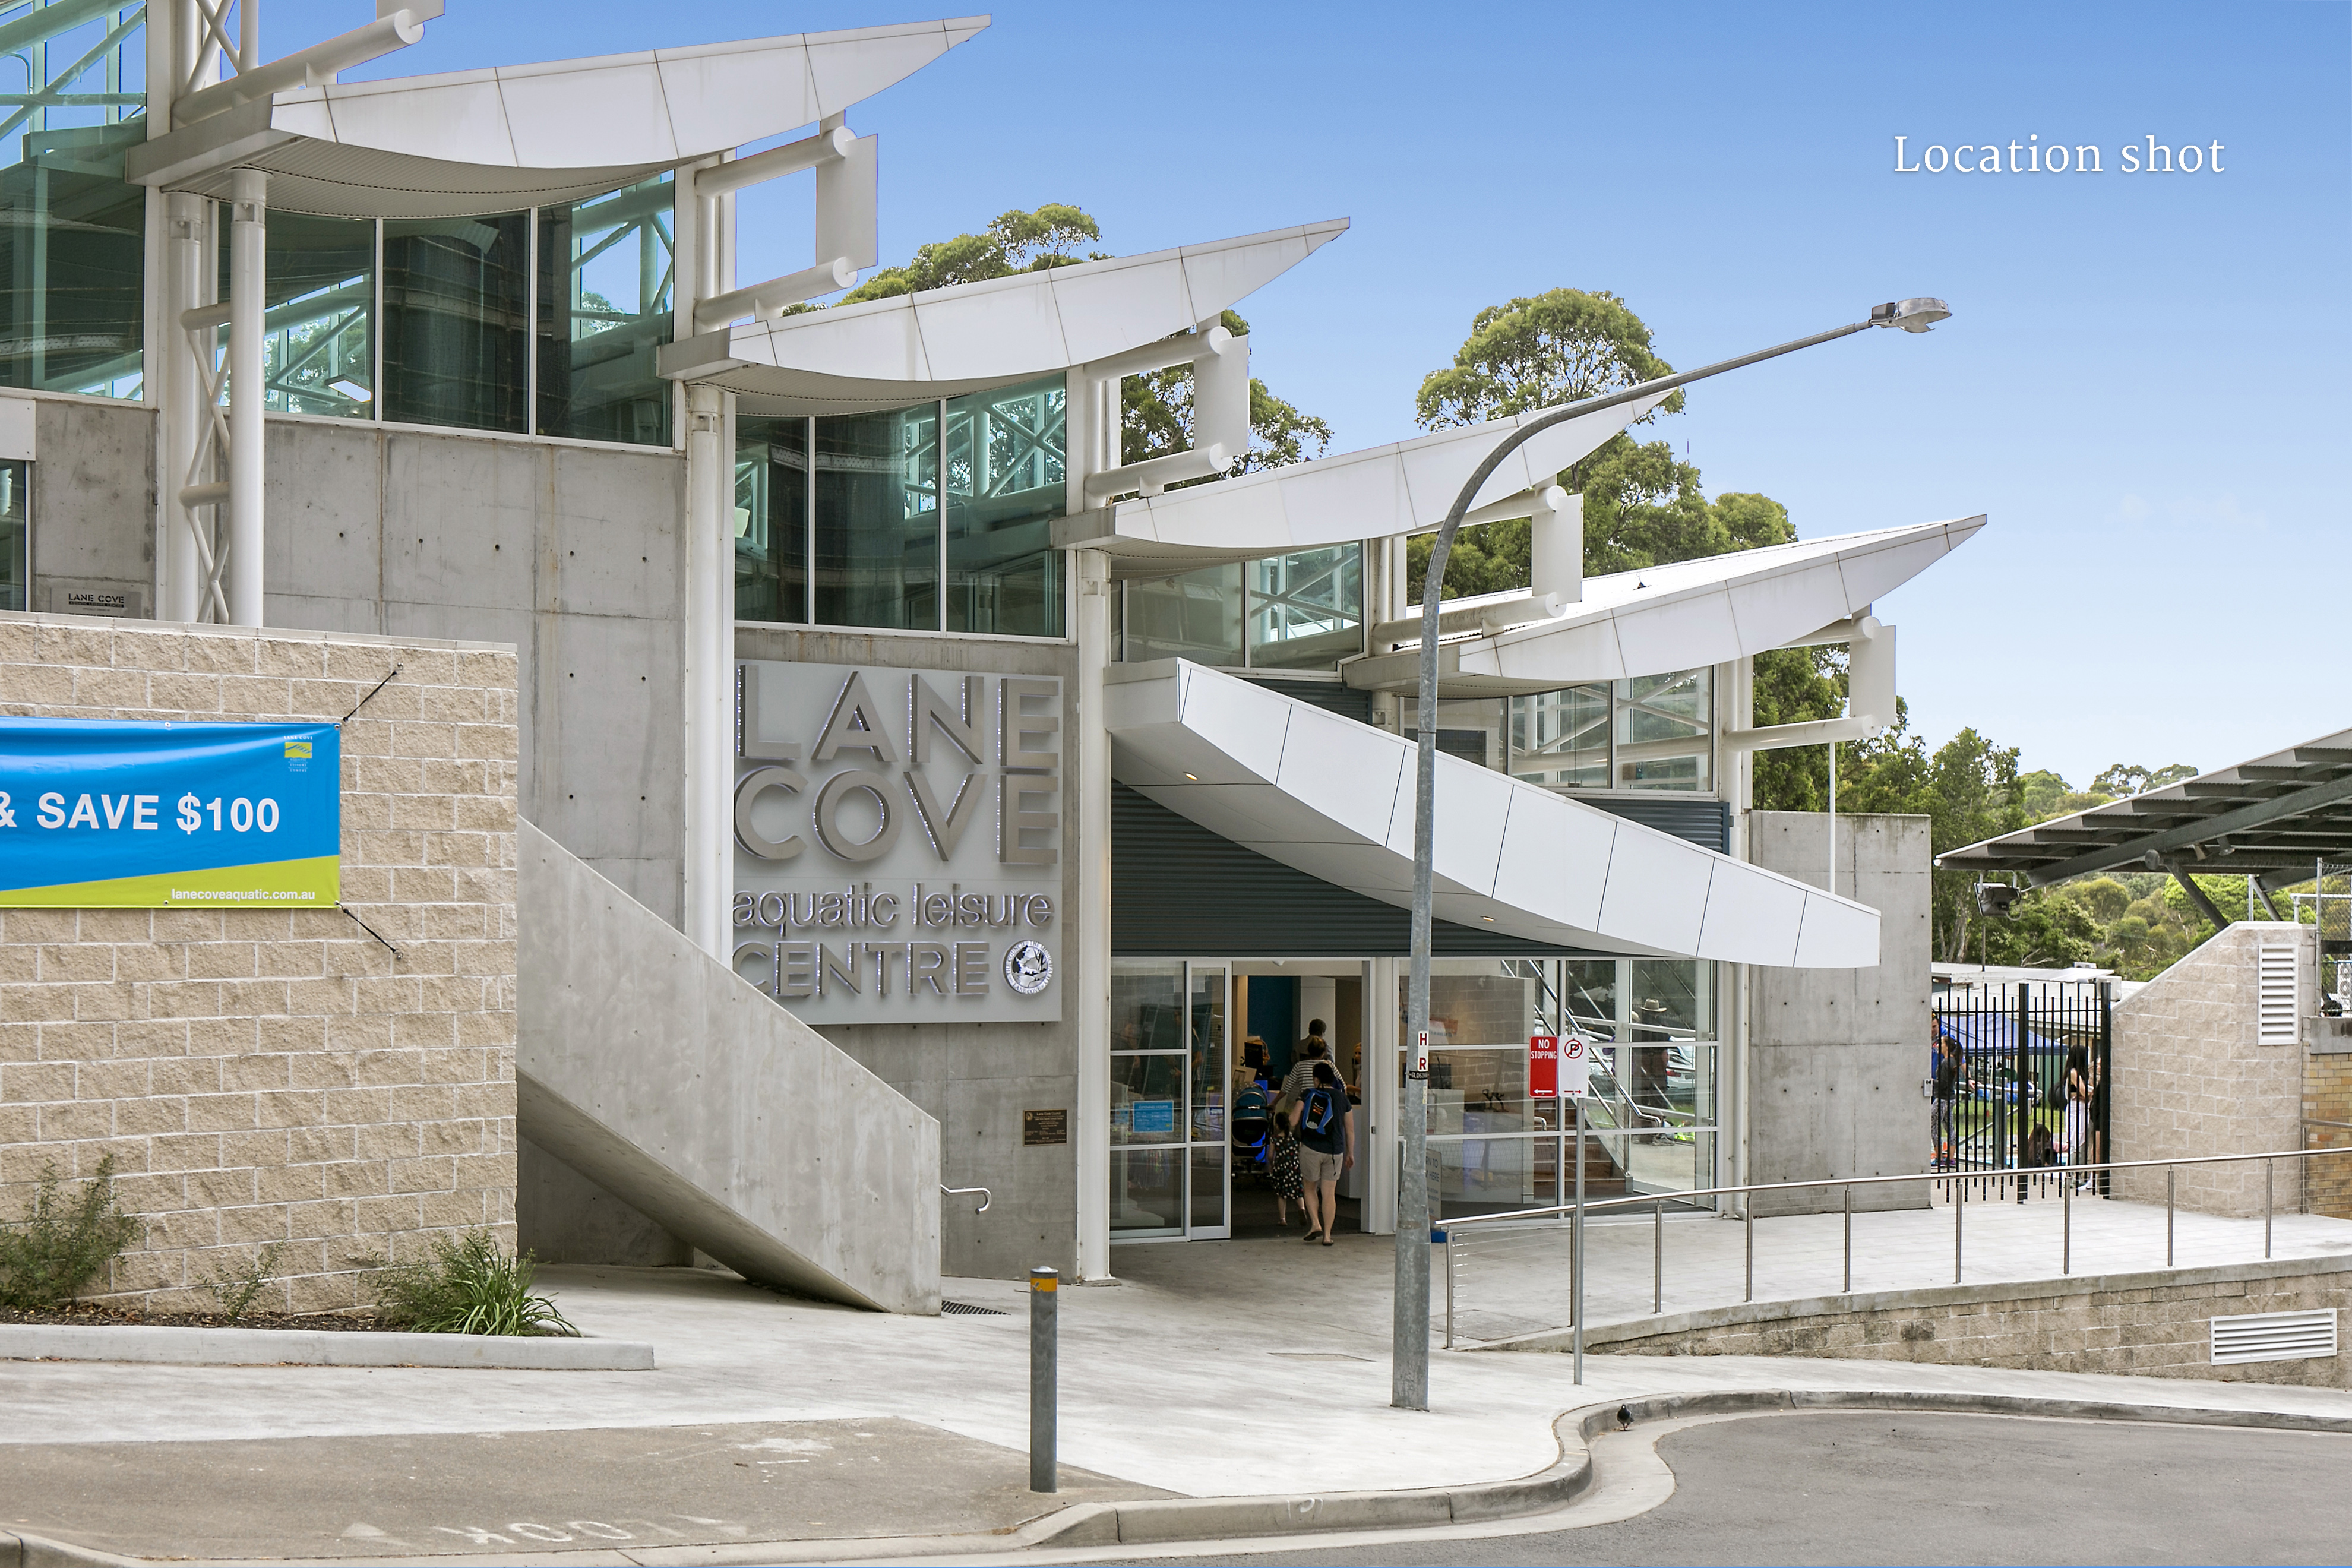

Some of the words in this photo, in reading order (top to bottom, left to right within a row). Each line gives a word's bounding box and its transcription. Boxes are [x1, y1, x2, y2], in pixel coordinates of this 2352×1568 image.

[68, 593, 94, 602] LANE
[98, 595, 124, 603] COVE
[738, 665, 1059, 767] LANE
[37, 792, 159, 830] SAVE
[176, 792, 280, 835] $100
[734, 766, 1059, 863] COVE
[171, 888, 315, 902] lanecoveaquatic.com.au
[733, 882, 901, 937] aquatic
[913, 882, 1055, 928] leisure
[733, 941, 990, 996] CENTRE
[1531, 1051, 1557, 1059] STOPPING
[1538, 1039, 1550, 1049] NO
